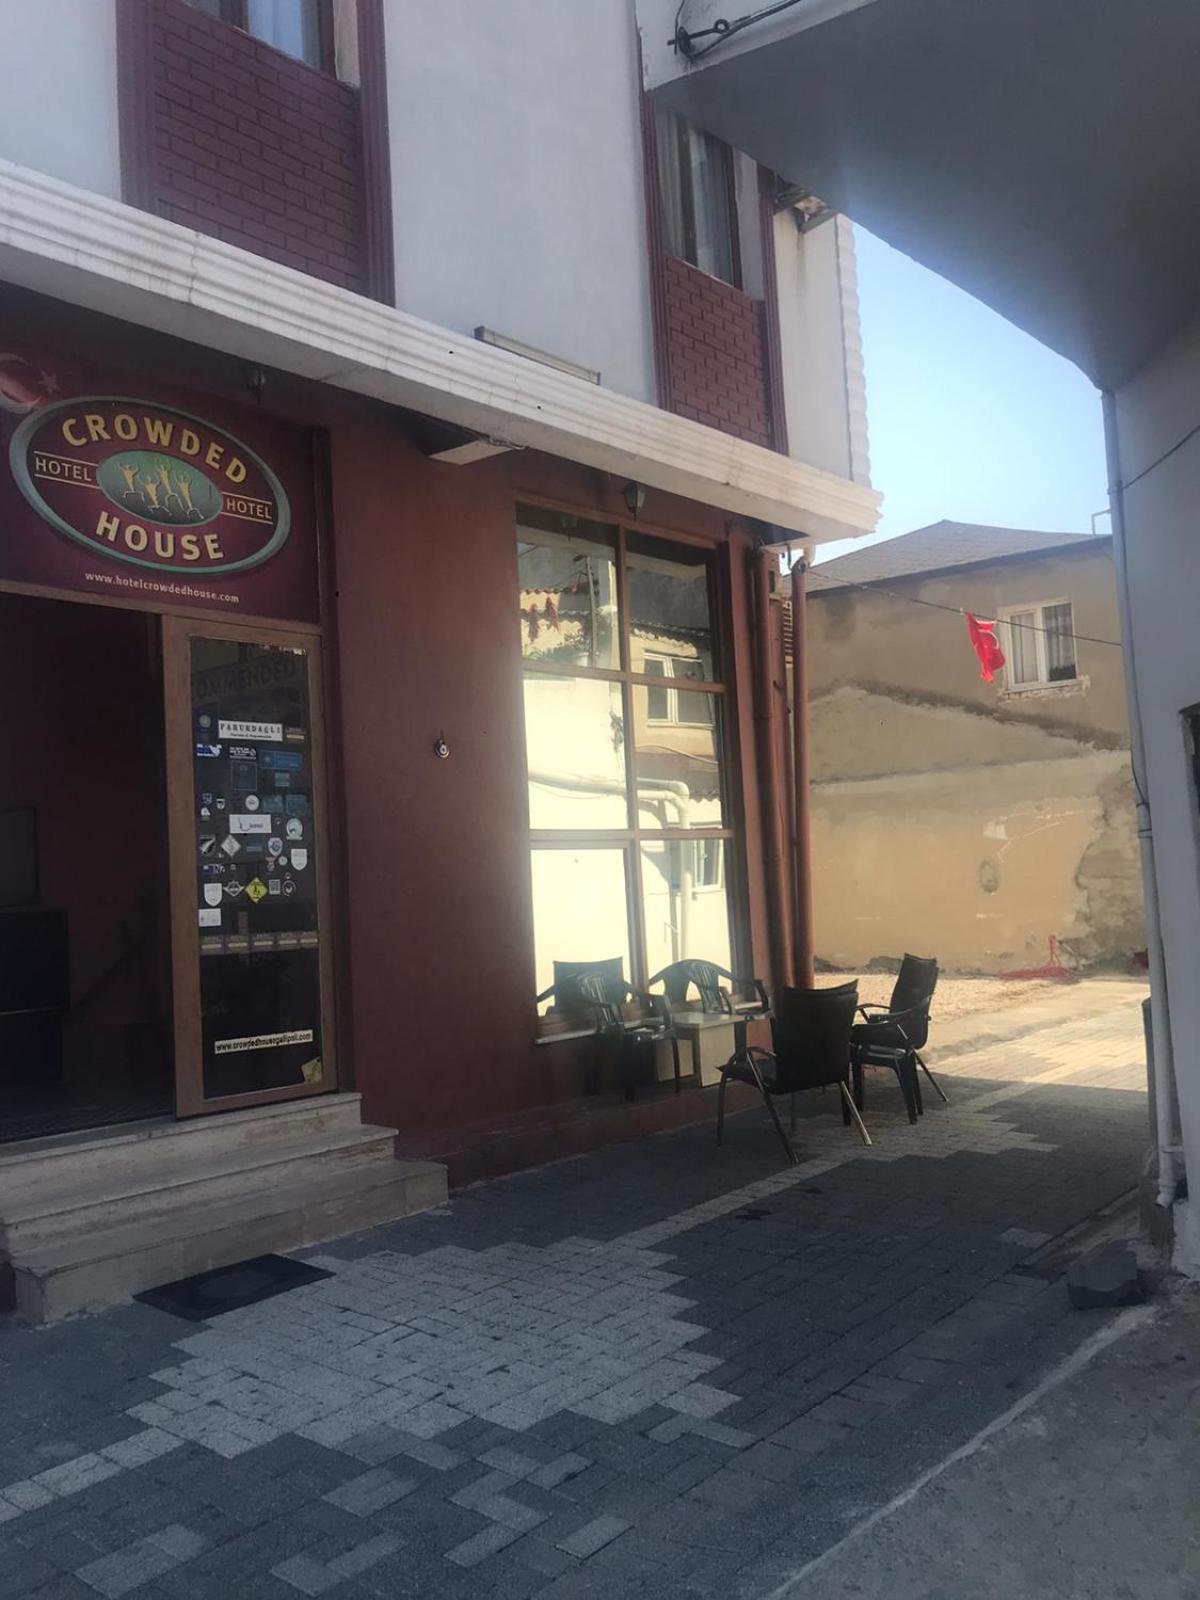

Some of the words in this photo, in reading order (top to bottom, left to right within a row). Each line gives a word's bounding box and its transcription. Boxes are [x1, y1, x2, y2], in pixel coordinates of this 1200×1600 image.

[62, 414, 248, 484] CROWDED
[35, 457, 92, 482] HOTEL
[226, 498, 272, 519] HOTEL
[95, 511, 224, 561] HOUSE
[85, 571, 240, 604] www.hotelcrowdedhouse.com
